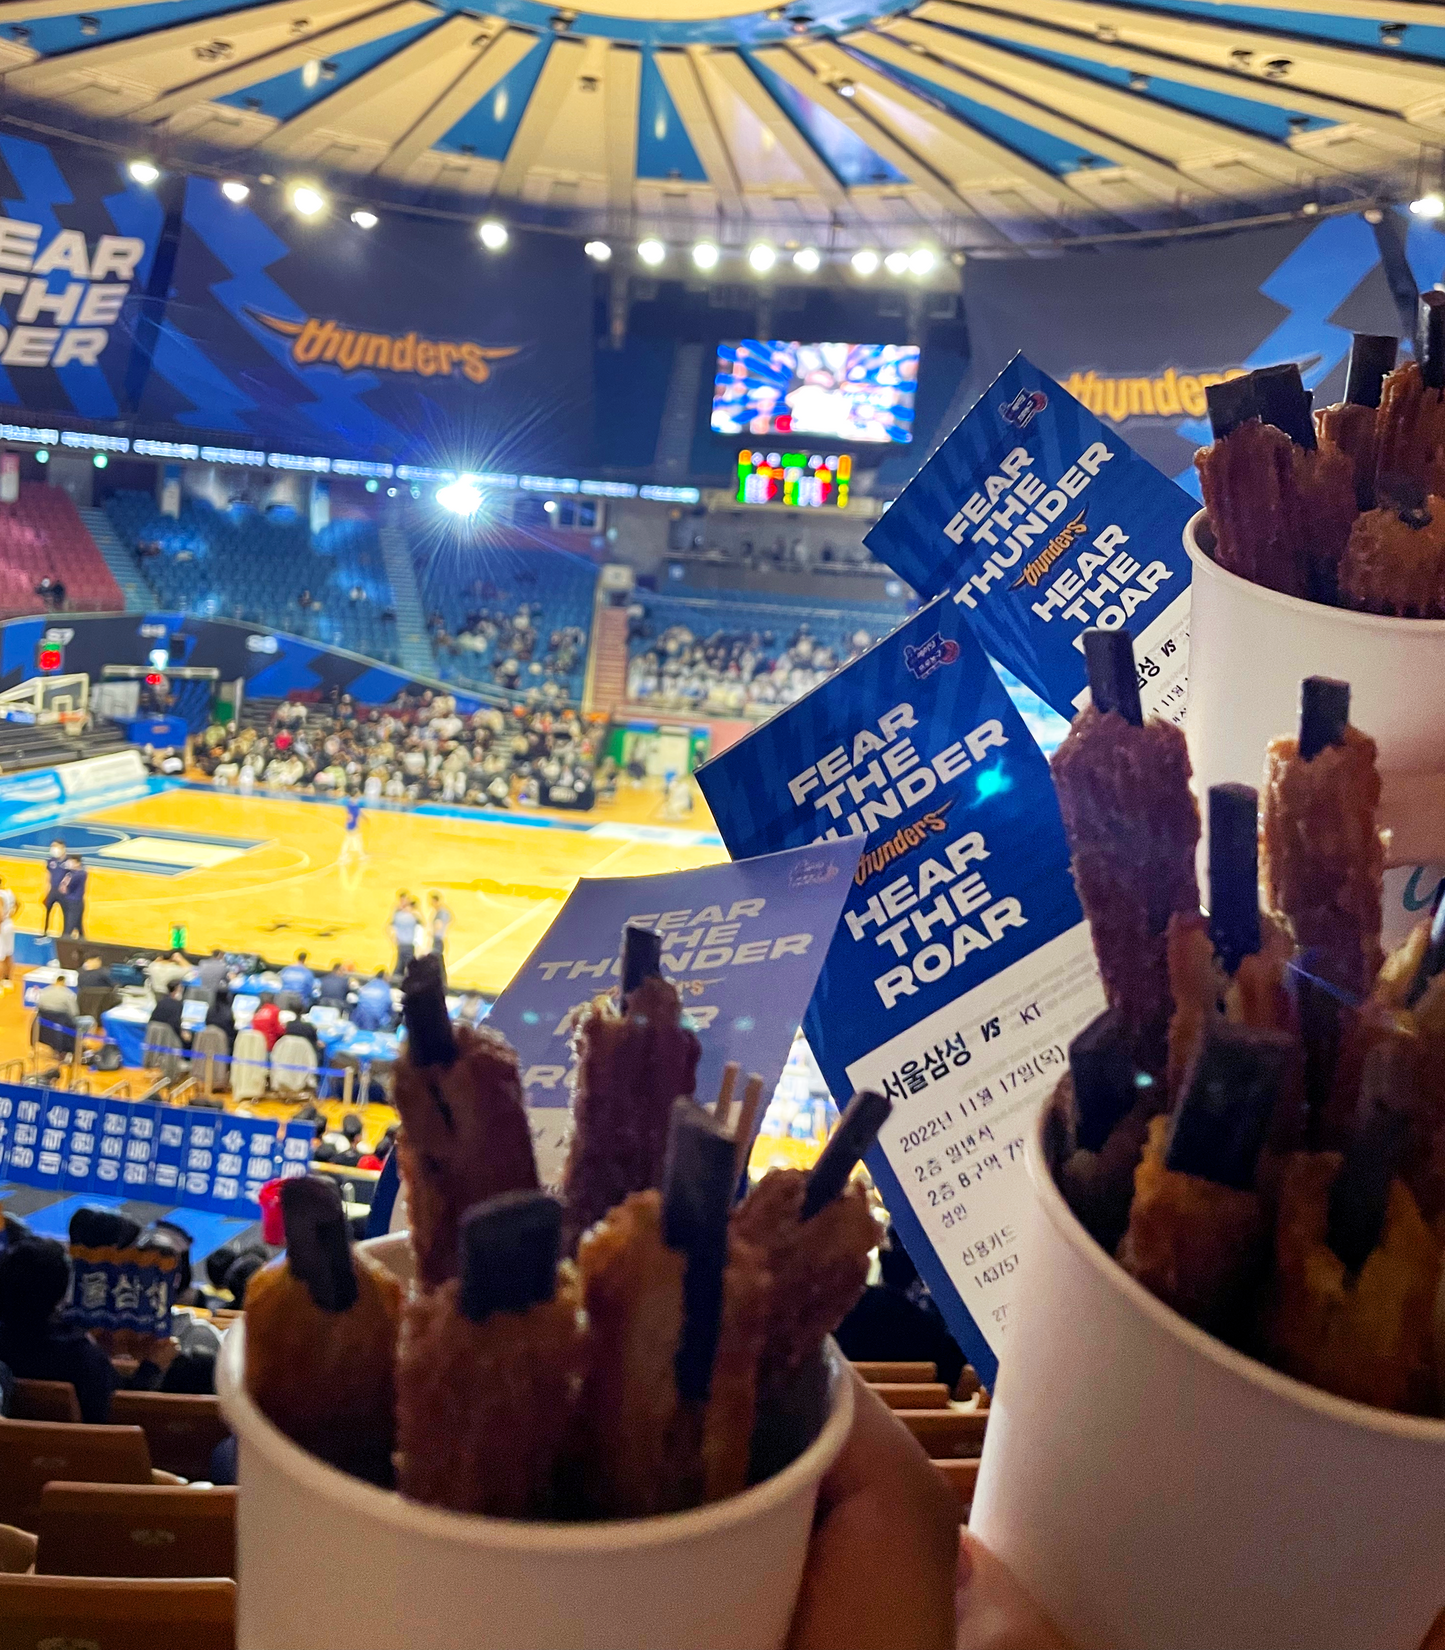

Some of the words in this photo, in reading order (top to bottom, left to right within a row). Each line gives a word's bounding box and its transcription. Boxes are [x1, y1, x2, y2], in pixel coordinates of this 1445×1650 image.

[0, 324, 109, 368] ER
[1060, 366, 1245, 423] thunde
[943, 447, 1034, 545] FEAR
[953, 442, 1114, 609] THUNDER
[971, 473, 1047, 546] THE
[1013, 512, 1088, 588] thunders
[1031, 524, 1129, 622] HEAR
[1061, 552, 1141, 623] THE
[787, 702, 919, 806] FEAR
[811, 719, 1009, 845] UNDER
[814, 737, 920, 818] THE
[627, 898, 766, 929] FEAR
[844, 831, 991, 941] HEAR
[876, 872, 992, 958] THE
[538, 933, 814, 981] THNDER
[660, 922, 742, 951] HE
[874, 897, 1028, 1009] ROAR
[882, 1031, 971, 1100] 서울삼성
[1019, 1002, 1041, 1025] KT
[900, 1111, 953, 1153] 2022년
[959, 1087, 994, 1118] 11월
[999, 1045, 1066, 1094] 17일(목)
[942, 1204, 967, 1229] 성인
